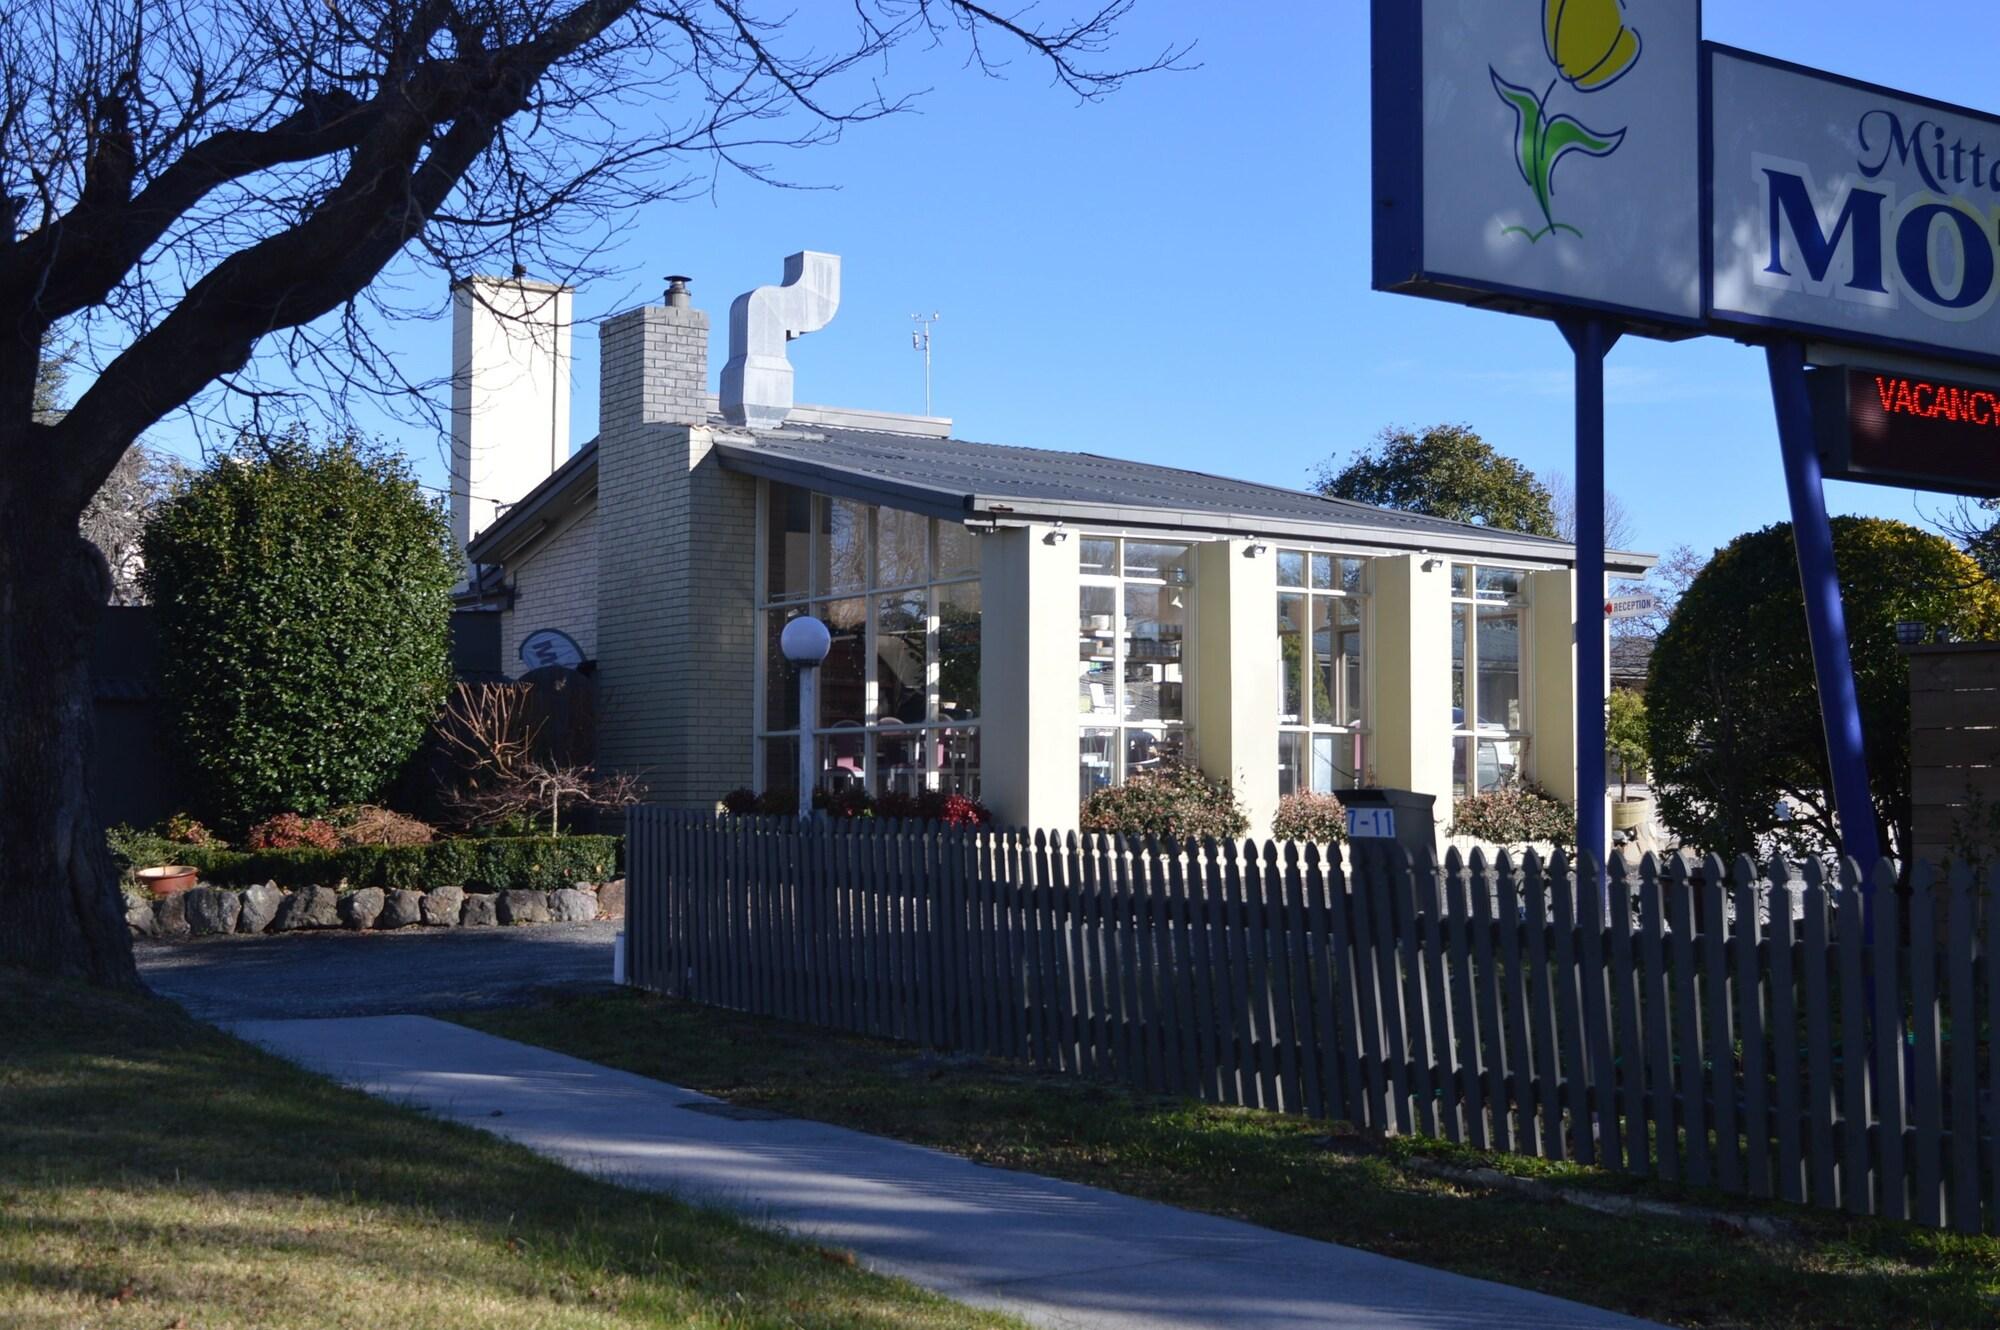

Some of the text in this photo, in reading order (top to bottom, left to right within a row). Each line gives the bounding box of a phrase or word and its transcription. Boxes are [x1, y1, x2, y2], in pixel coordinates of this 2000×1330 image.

[1761, 168, 2000, 309] MO
[1613, 599, 1652, 612] RECEPTION
[1347, 809, 1393, 836] 7-11
